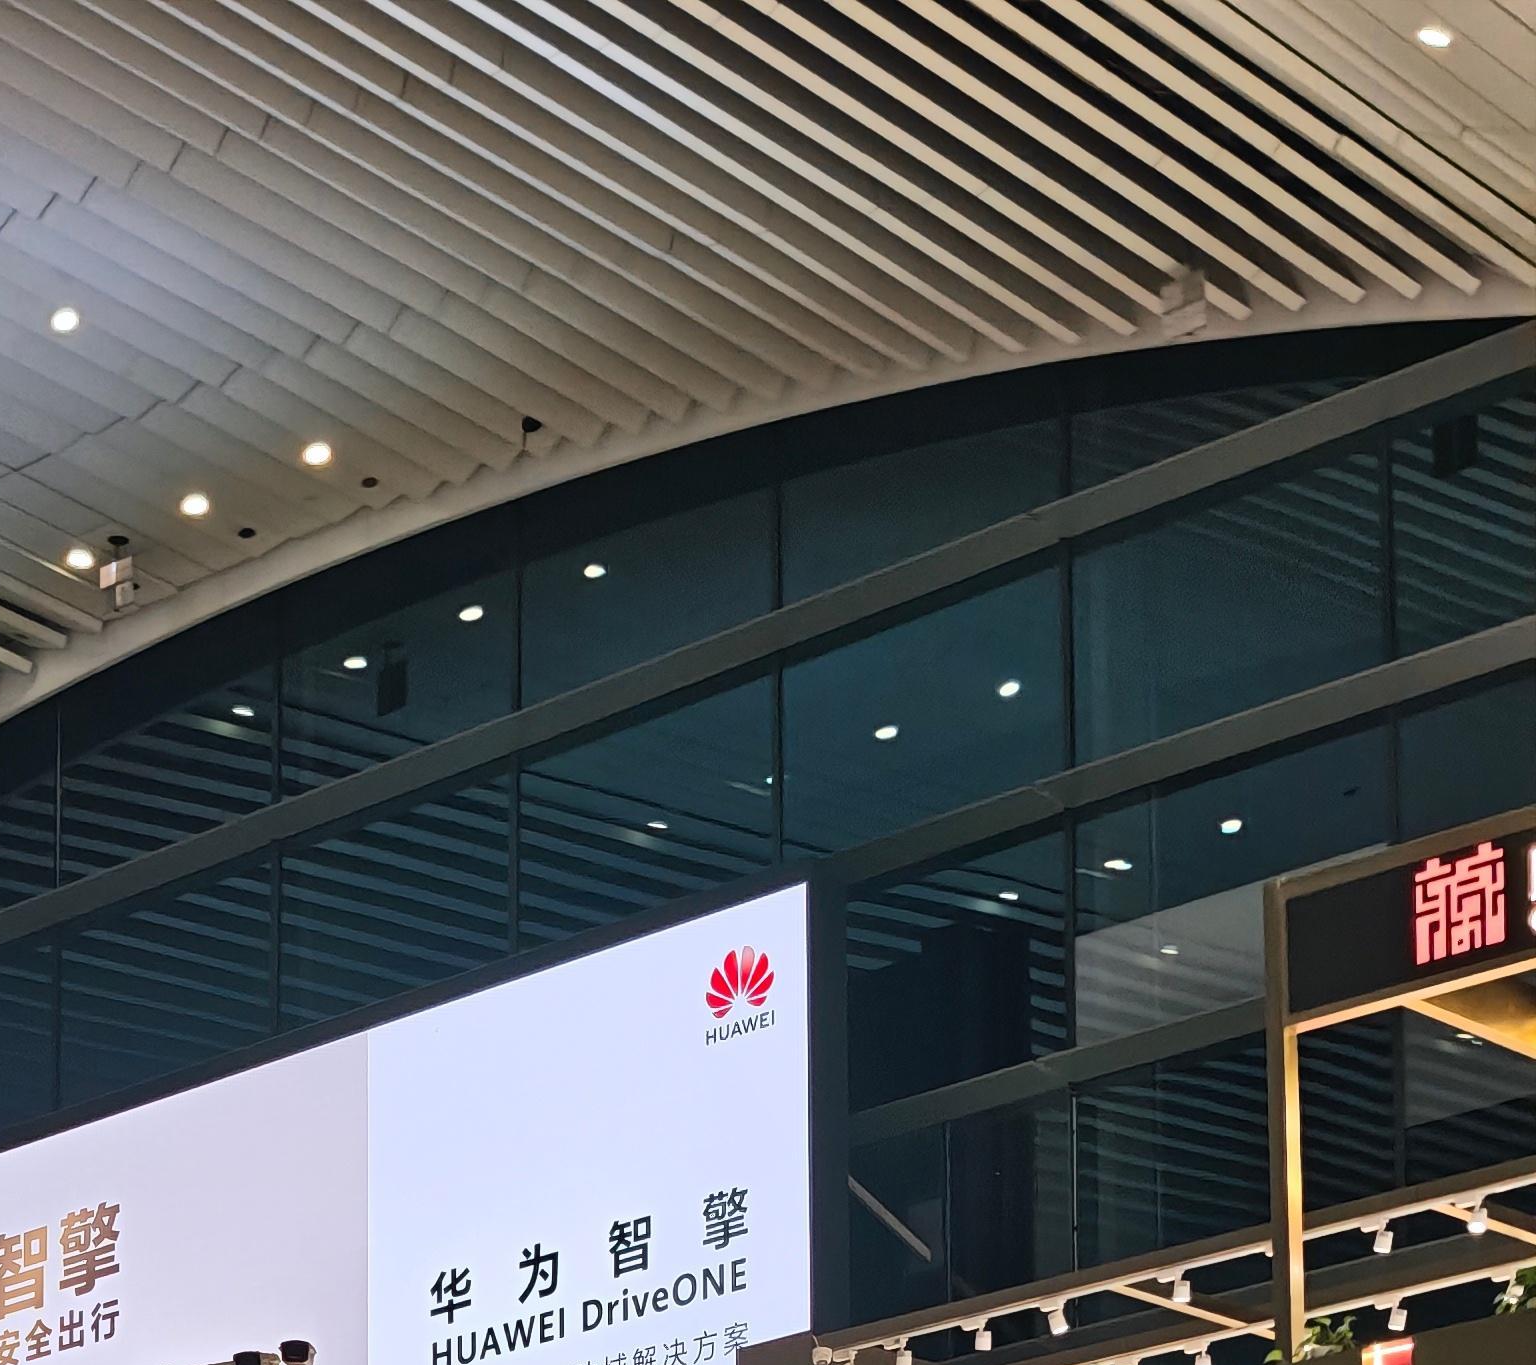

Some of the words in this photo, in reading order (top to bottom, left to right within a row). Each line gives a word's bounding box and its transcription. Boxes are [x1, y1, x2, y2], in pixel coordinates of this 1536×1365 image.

[705, 1009, 776, 1046] HUAWEI
[429, 1186, 750, 1325] 华为智擎
[581, 1257, 749, 1333] DriveONE
